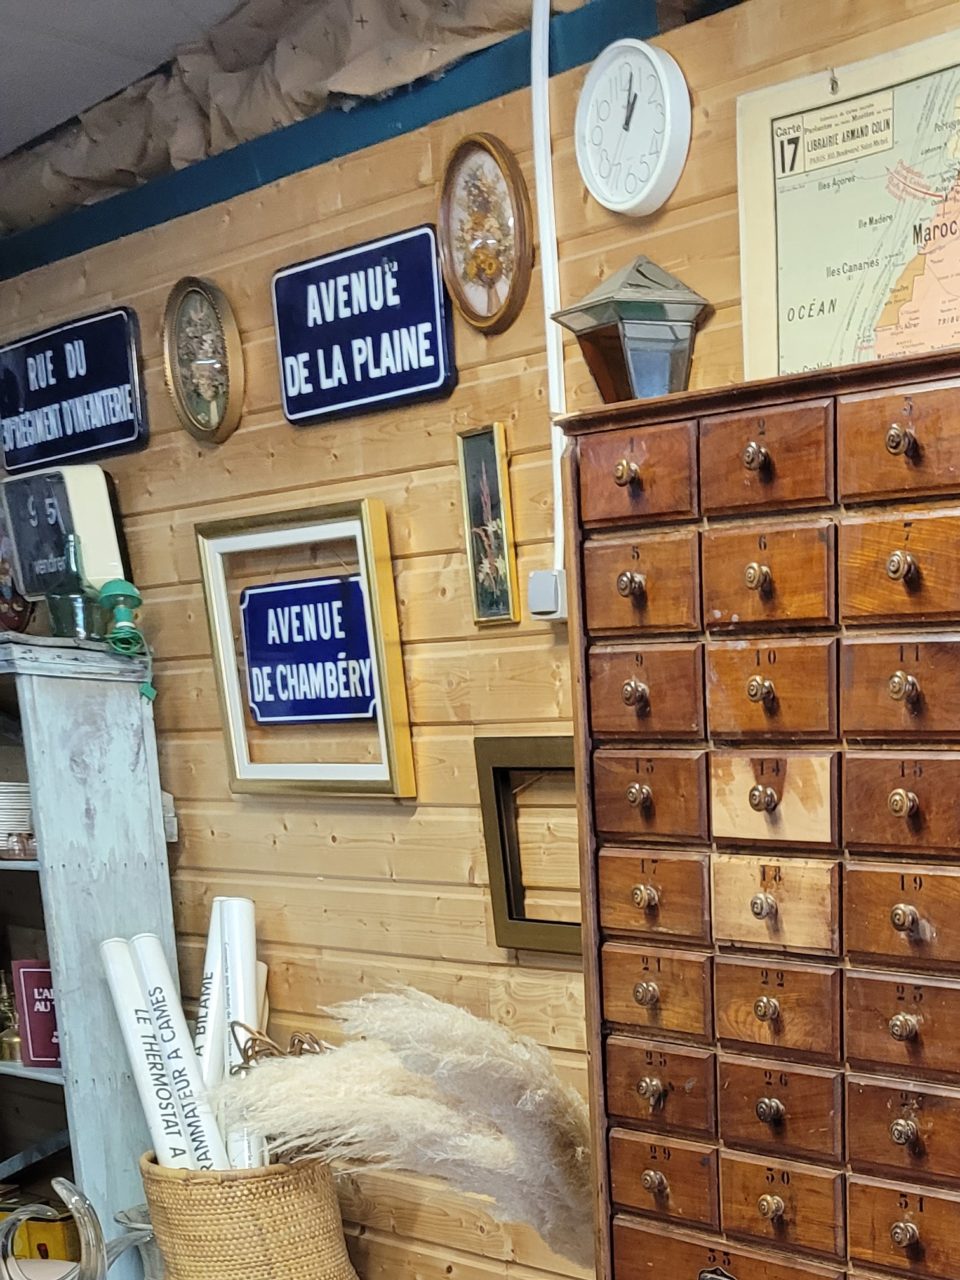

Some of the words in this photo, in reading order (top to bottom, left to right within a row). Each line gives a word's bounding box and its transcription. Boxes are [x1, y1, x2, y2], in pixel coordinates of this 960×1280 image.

[776, 124, 801, 138] Carte
[780, 137, 800, 173] 17
[913, 220, 958, 245] Maroc
[842, 258, 880, 274] Canaries
[307, 262, 400, 327] AVENUE
[788, 298, 837, 322] OCÉAN
[27, 350, 57, 391] RUE
[64, 340, 87, 379] DU
[284, 352, 313, 397] DE
[317, 345, 348, 389] LA
[352, 322, 434, 383] PLAINE
[757, 418, 766, 436] 2
[758, 535, 767, 551] 6
[631, 545, 640, 561] 5
[268, 600, 346, 645] AVENUE
[635, 655, 643, 667] 9
[754, 649, 776, 666] 10
[899, 645, 919, 662] 11
[251, 666, 275, 702] DE
[276, 652, 371, 701] CHAMBÉRY
[760, 759, 781, 776] 14
[899, 760, 923, 778] 15
[640, 858, 659, 875] 17
[760, 865, 781, 882] 18
[899, 874, 923, 891] 19
[641, 956, 661, 973] 21
[760, 970, 786, 987] 22
[196, 972, 213, 1036] BILAME
[135, 1008, 152, 1025] LE
[148, 986, 177, 1044] CAMES
[167, 1048, 183, 1060] A
[645, 1050, 667, 1067] 25
[141, 1034, 182, 1137] THERMOSTAT
[764, 1070, 788, 1087] 26
[168, 1146, 186, 1159] A
[650, 1145, 671, 1161] 29
[765, 1168, 790, 1185] 30
[899, 1194, 924, 1213] 31
